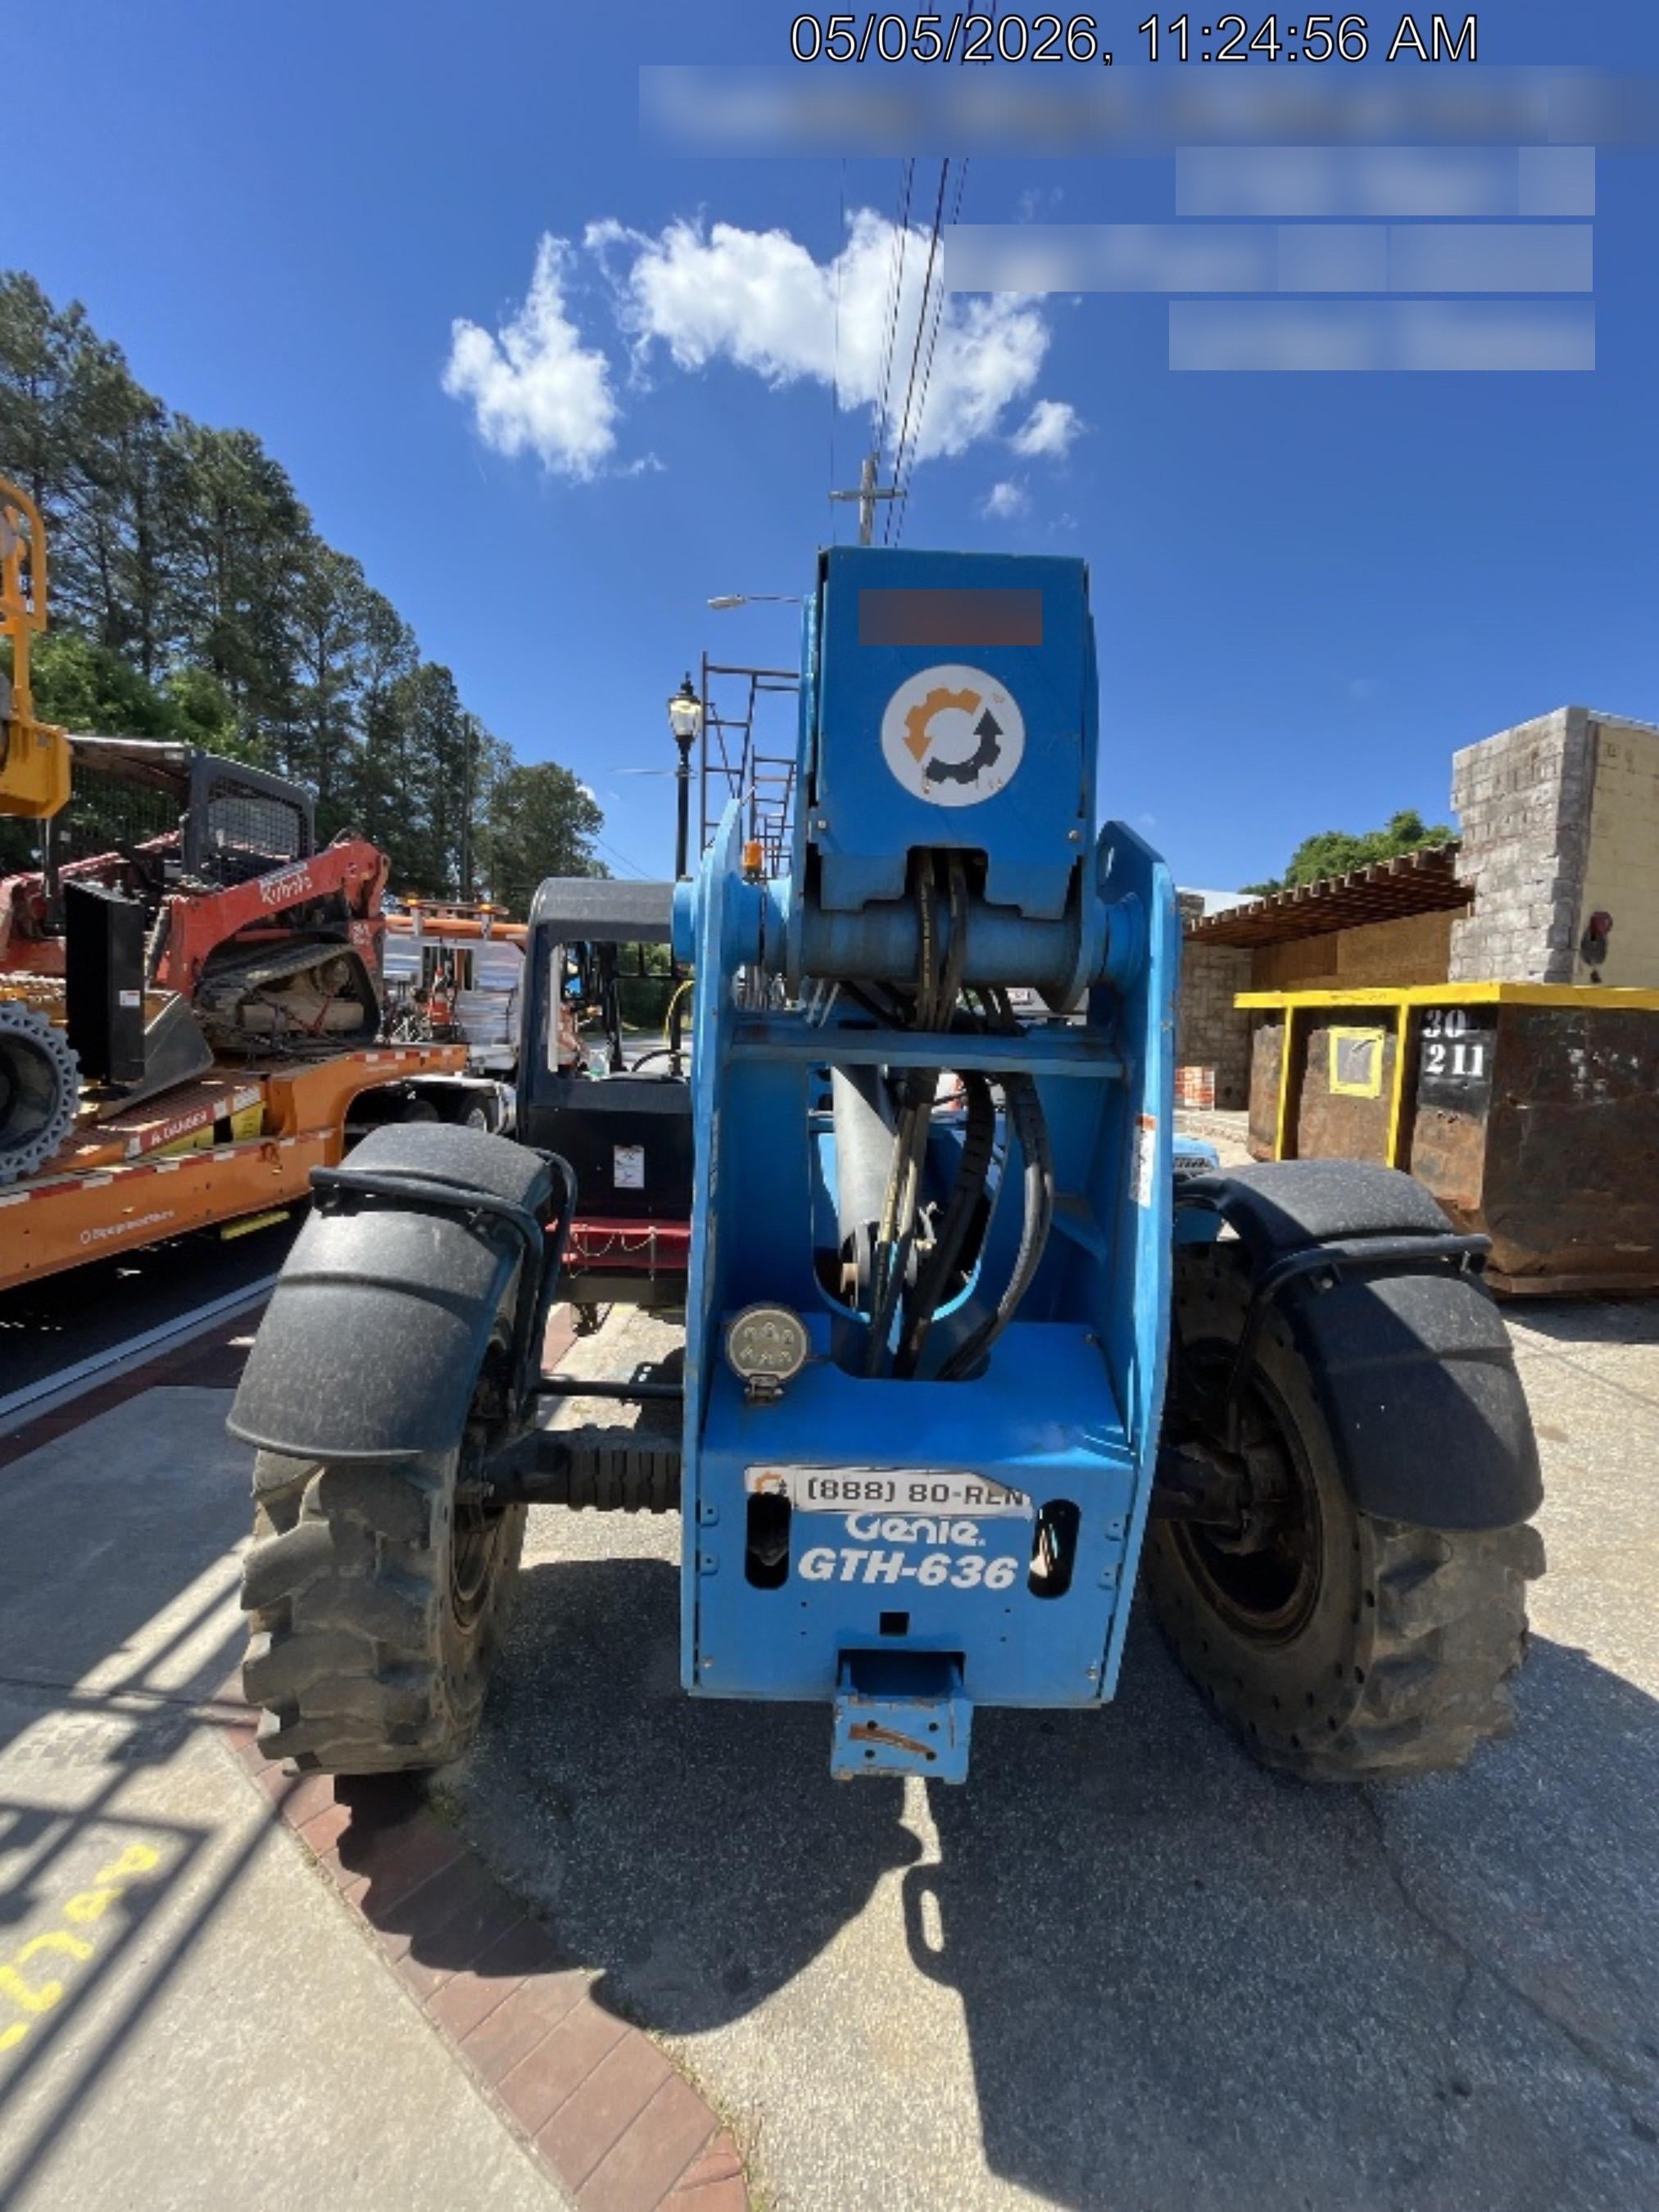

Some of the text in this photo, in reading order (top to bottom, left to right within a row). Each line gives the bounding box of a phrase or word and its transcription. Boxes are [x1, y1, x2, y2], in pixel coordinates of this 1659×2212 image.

[1422, 1009, 1466, 1039] 30
[1425, 1043, 1484, 1078] 211
[807, 1478, 896, 1503] (888)
[797, 1547, 1019, 1590] GTH-636
